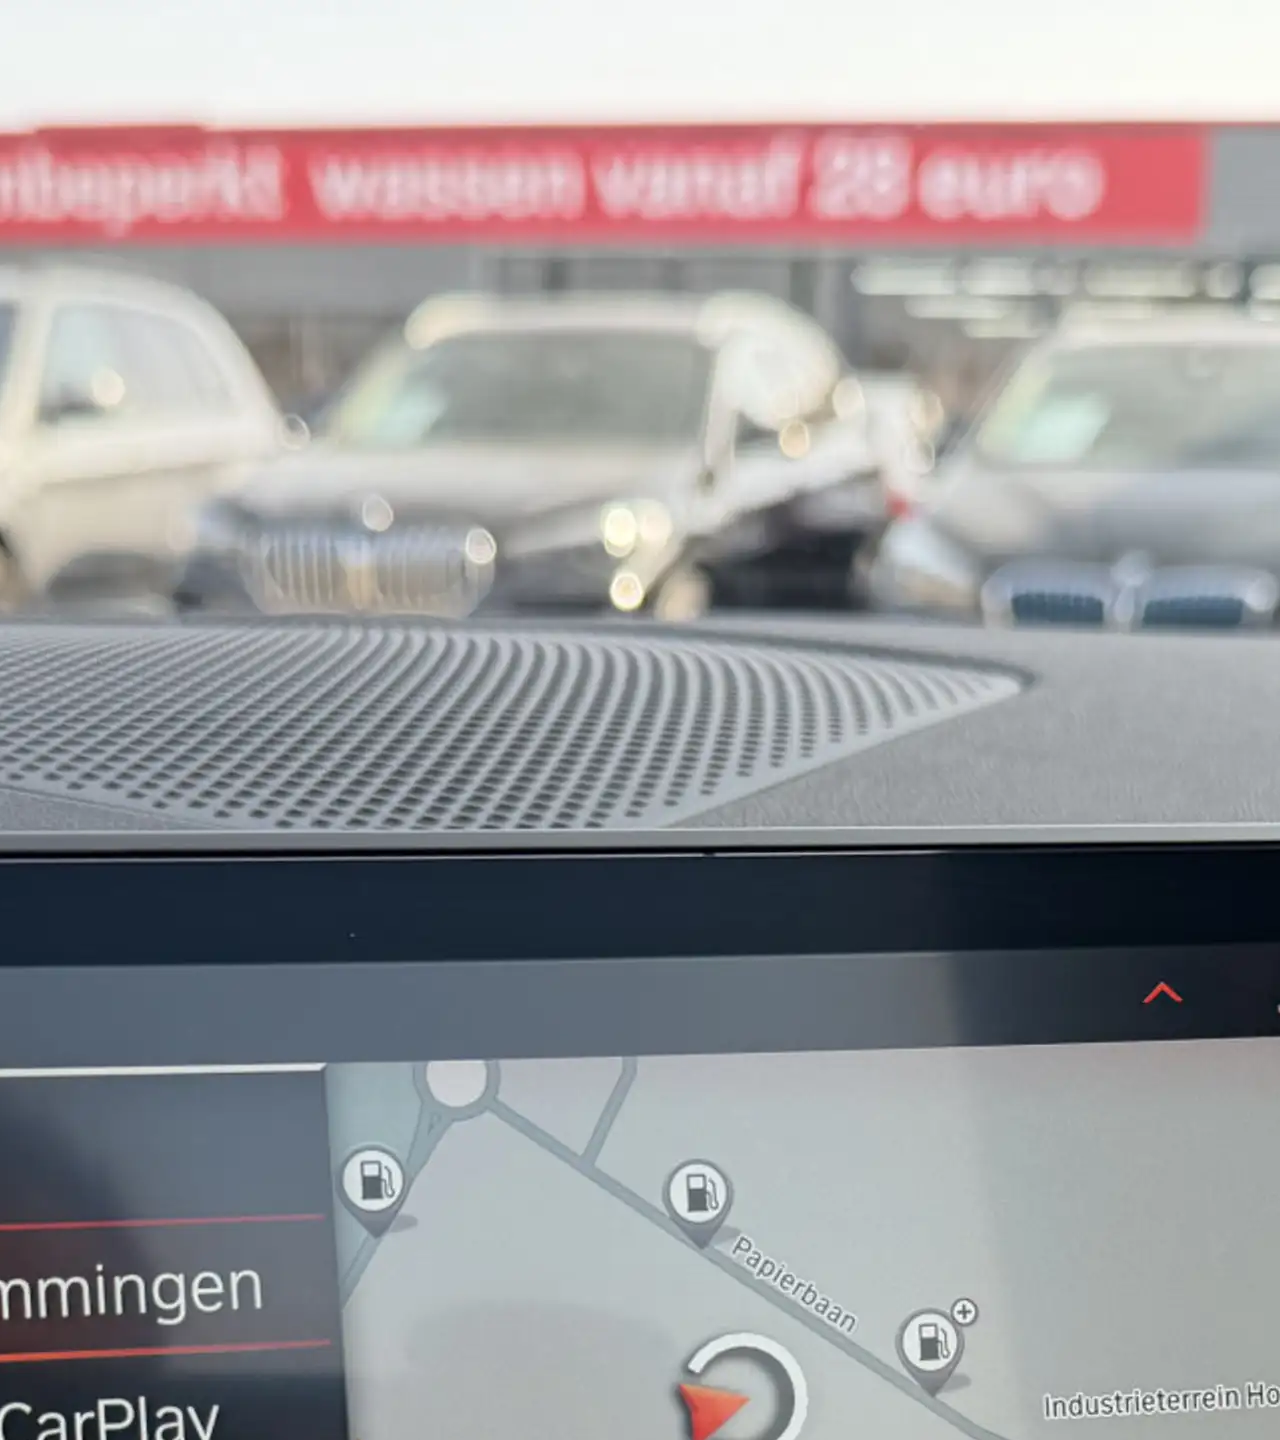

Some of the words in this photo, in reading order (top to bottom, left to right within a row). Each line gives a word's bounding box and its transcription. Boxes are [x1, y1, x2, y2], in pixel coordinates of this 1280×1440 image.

[310, 146, 584, 222] wassen
[592, 132, 806, 220] vanaf
[917, 150, 1106, 221] euro
[730, 1236, 858, 1334] Papierbaan
[1044, 1387, 1240, 1420] Industrieterrein
